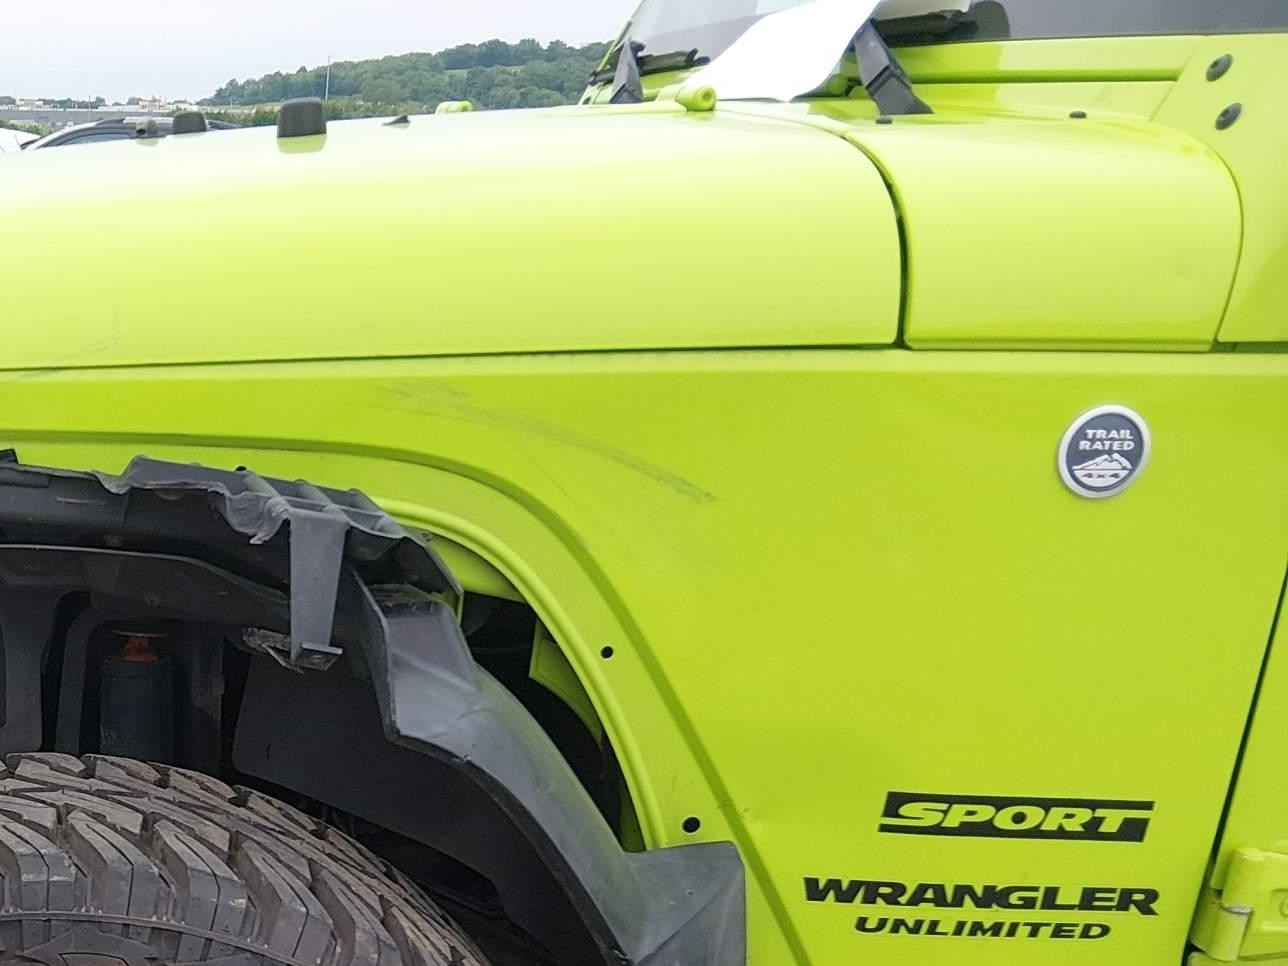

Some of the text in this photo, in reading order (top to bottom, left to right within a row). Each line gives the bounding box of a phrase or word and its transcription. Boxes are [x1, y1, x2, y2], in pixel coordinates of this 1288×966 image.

[1078, 440, 1135, 451] RATED
[1085, 429, 1134, 440] TRAIL
[881, 799, 1151, 834] SPORT
[803, 876, 1160, 916] WRANGLER
[855, 916, 1111, 939] UNLIMITED
